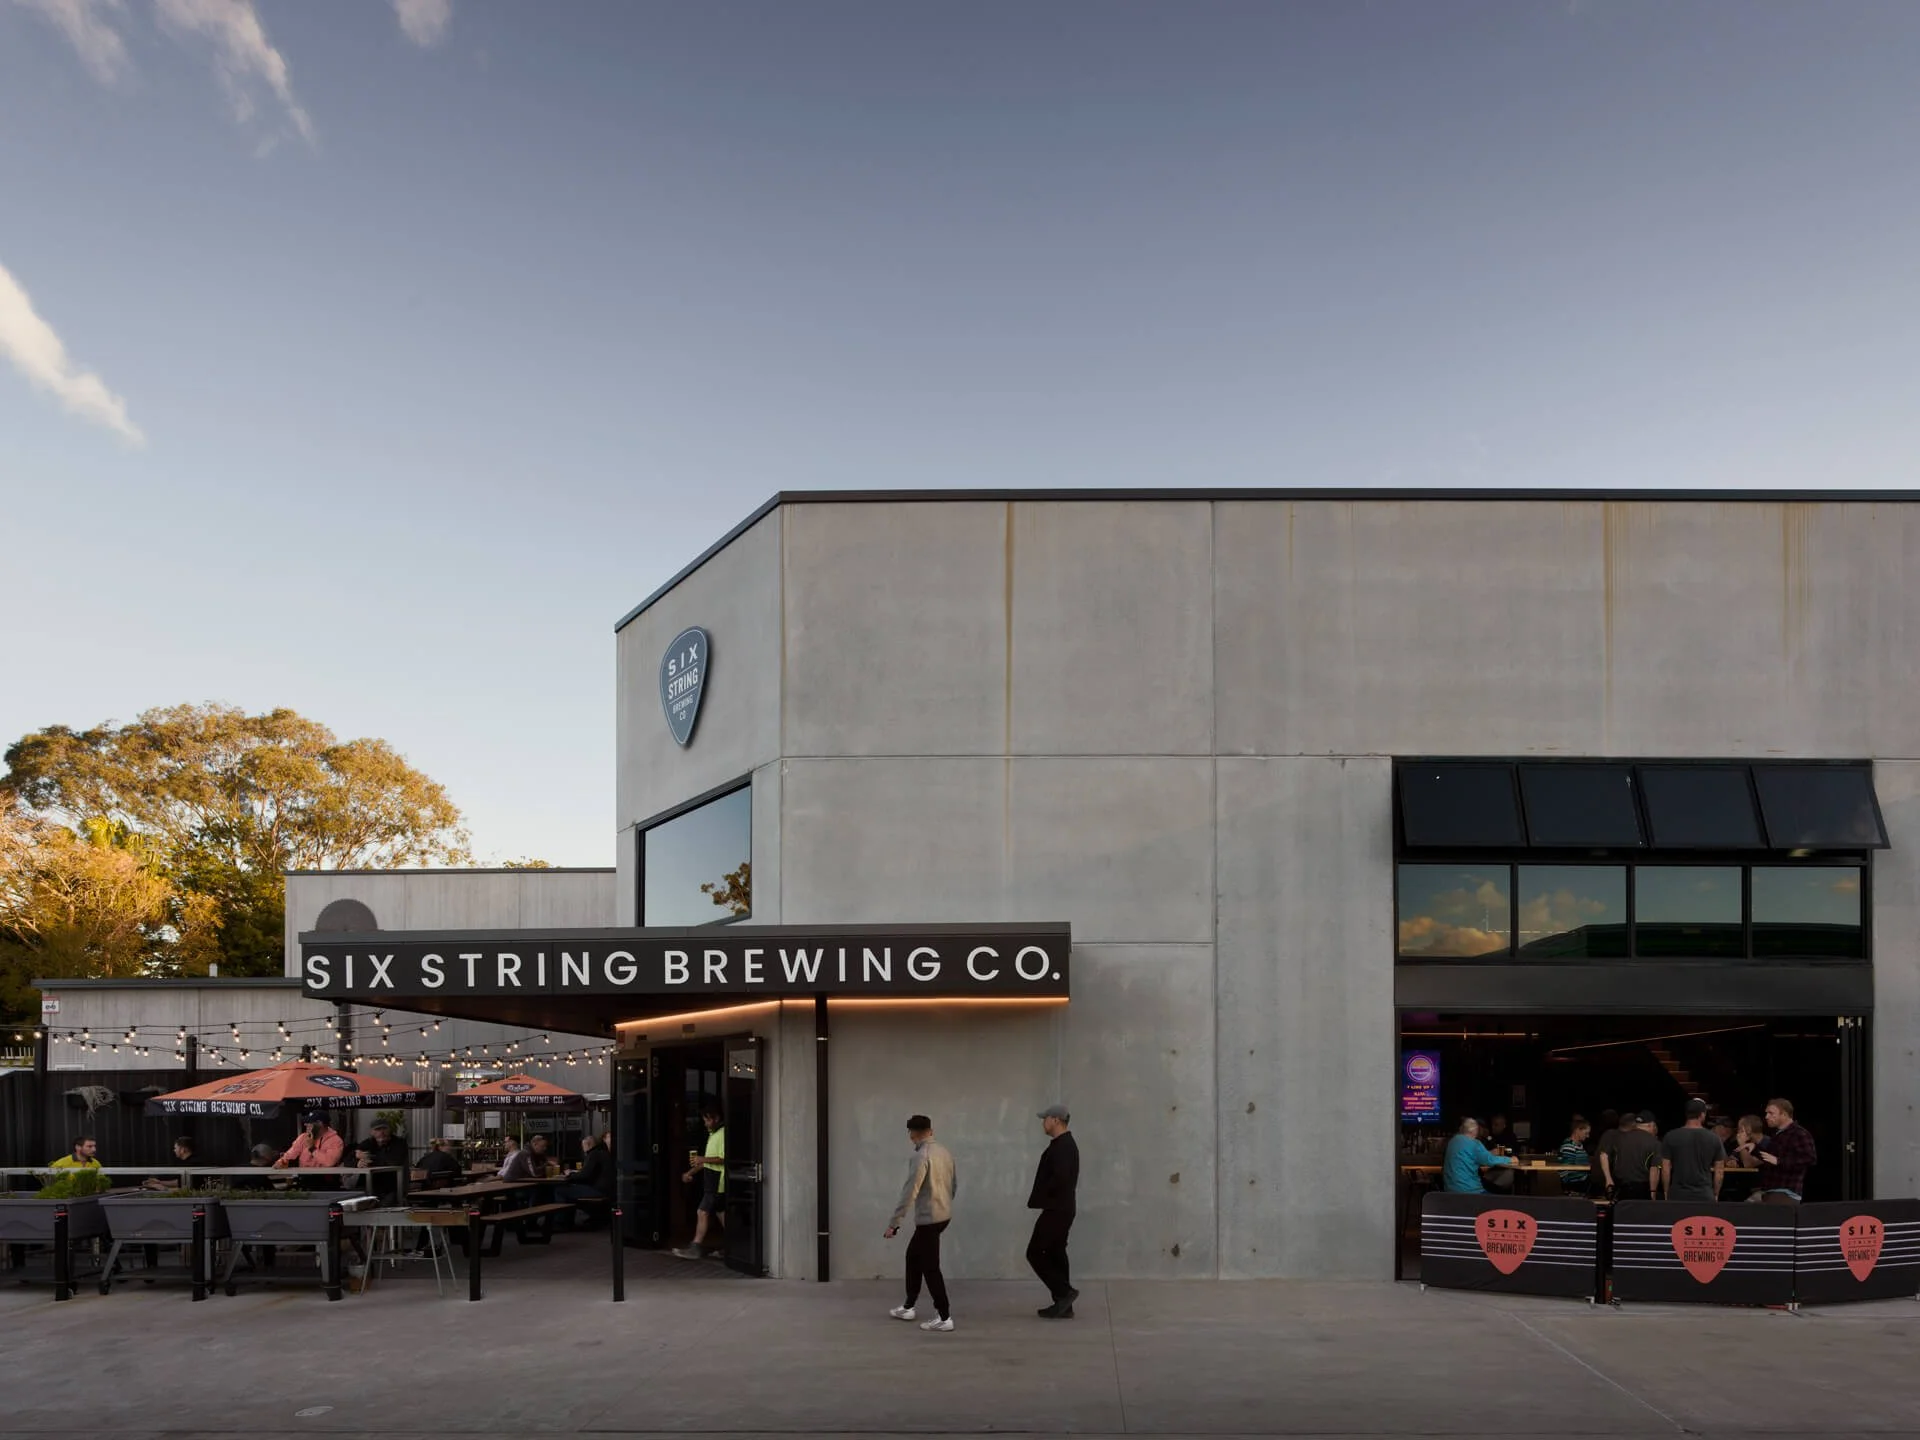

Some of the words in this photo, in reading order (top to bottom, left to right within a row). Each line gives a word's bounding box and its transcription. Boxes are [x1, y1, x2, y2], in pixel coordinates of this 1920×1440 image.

[668, 643, 698, 676] SIX
[668, 668, 698, 700] STRING
[672, 695, 694, 714] BREWING
[306, 954, 395, 990] SIX
[421, 950, 638, 987] STRING
[664, 947, 941, 984] BREWING
[966, 946, 1061, 981] CO.
[304, 1097, 323, 1108] SIX
[328, 1095, 362, 1108] STRING
[366, 1093, 402, 1105] BREWING
[464, 1095, 479, 1104] SIX
[483, 1095, 511, 1104] STRING
[515, 1095, 550, 1104] BREWING
[163, 1101, 176, 1112] SIX
[180, 1101, 207, 1113] STRING
[211, 1101, 247, 1114] BREWING
[249, 1103, 265, 1115] CO.
[1487, 1218, 1527, 1230] SIX
[1684, 1225, 1725, 1237] SIX
[1848, 1224, 1877, 1236] SIX
[1486, 1241, 1518, 1255] BREWING
[1683, 1250, 1716, 1263] BREWING
